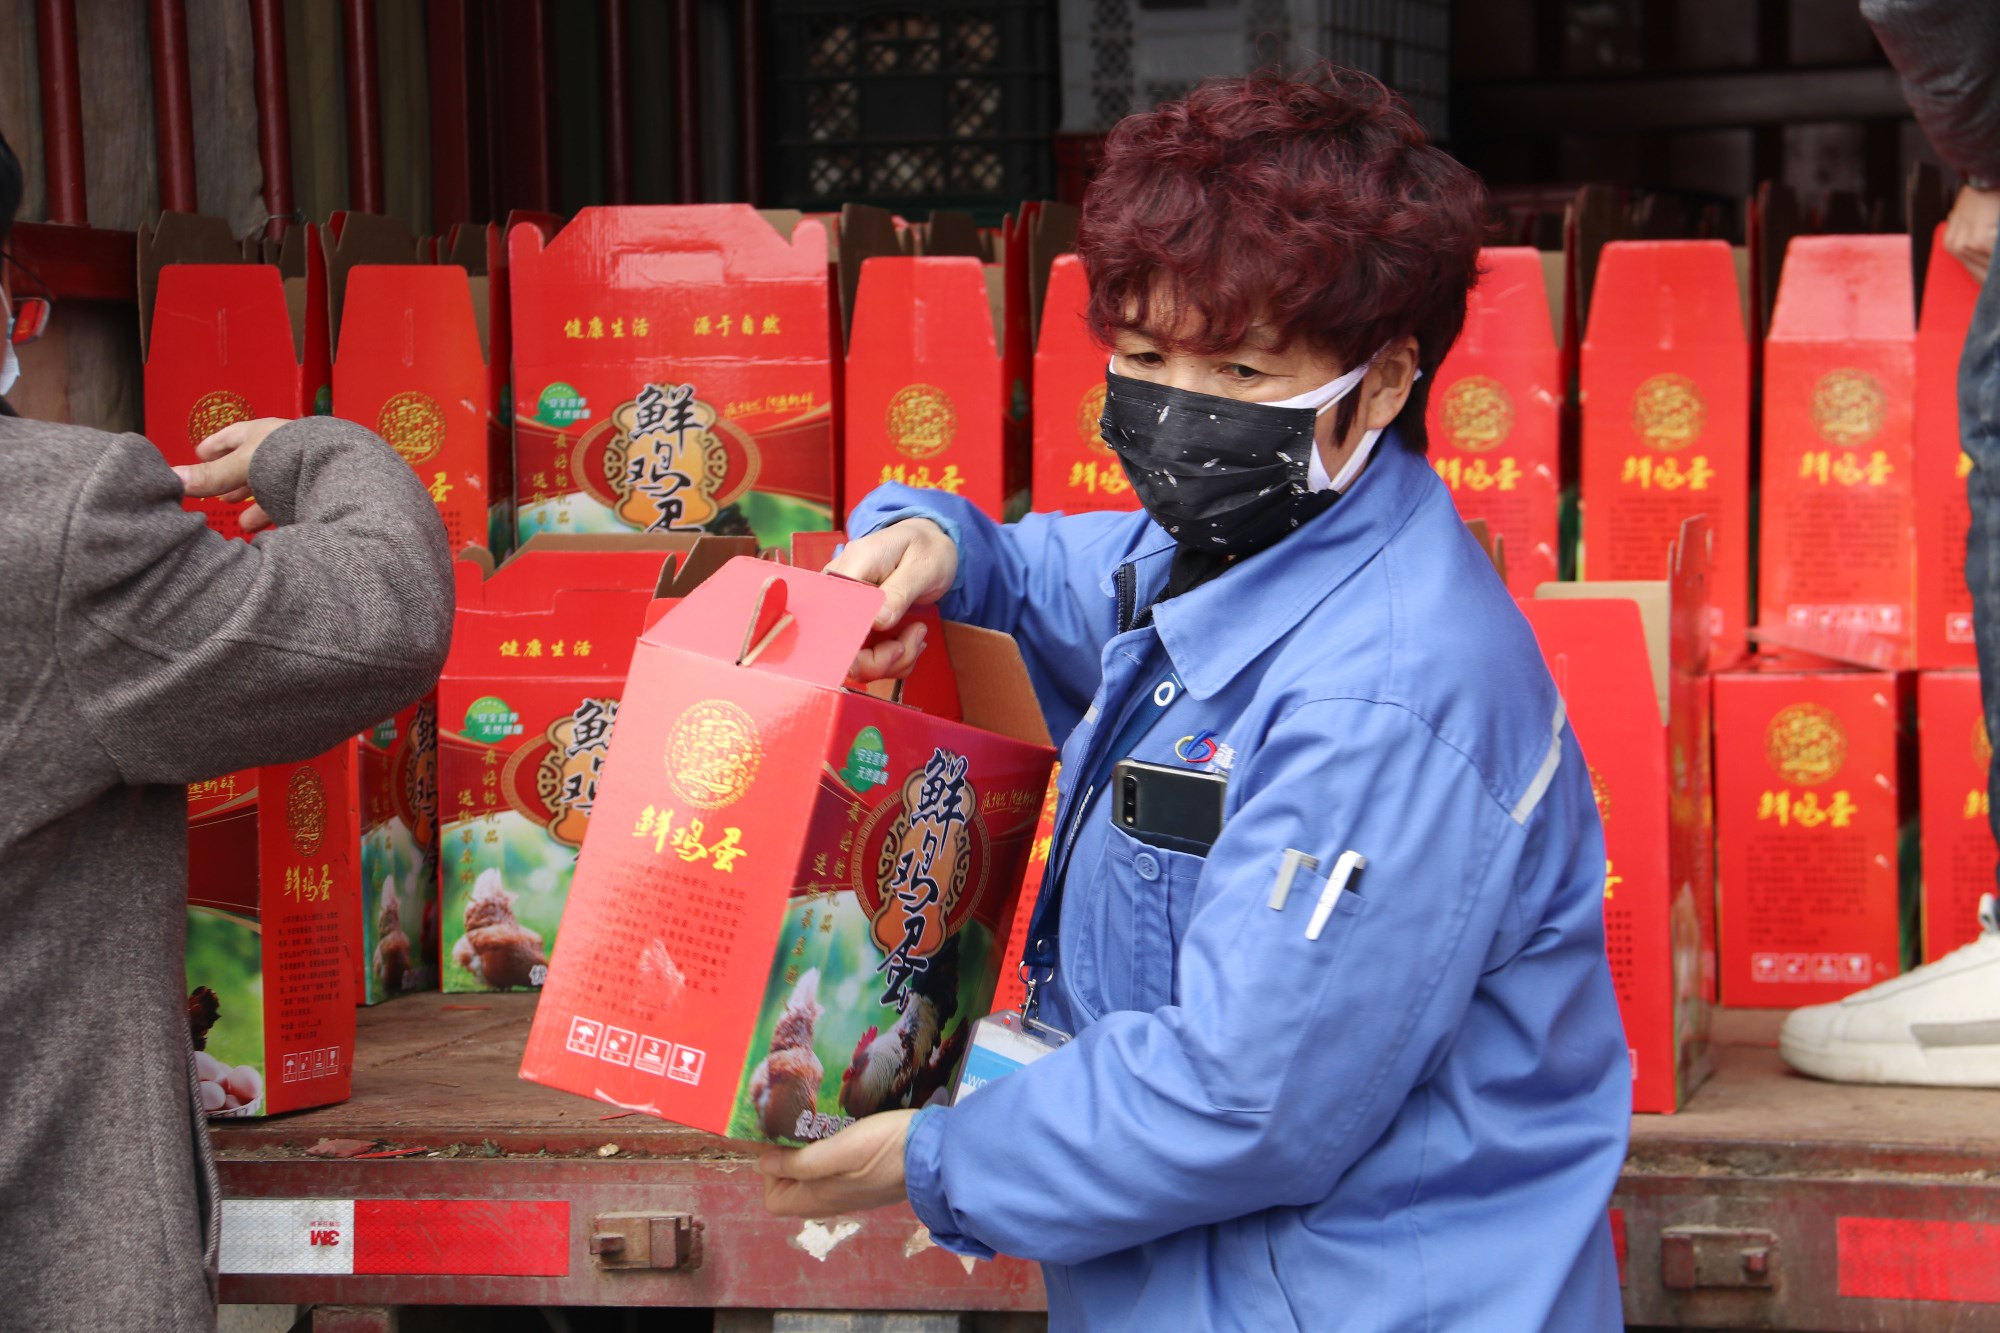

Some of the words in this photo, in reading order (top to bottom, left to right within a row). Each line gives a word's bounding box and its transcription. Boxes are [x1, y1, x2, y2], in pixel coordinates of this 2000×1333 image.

[564, 315, 650, 339] 健康生活
[693, 314, 782, 338] 源于自然
[1068, 460, 1131, 495] 鲜鸡
[1620, 454, 1716, 492] 鲜鸡蛋
[1798, 449, 1895, 486] 鲜鸡蛋
[499, 639, 593, 658] 健康生活
[476, 712, 520, 724] 安全营养
[481, 724, 524, 736] 天然健康
[1756, 789, 1859, 828] 鲜鸡蛋
[631, 803, 748, 874] 鲜鸡蛋
[283, 863, 334, 904] 鲜鸡蛋
[310, 1230, 340, 1247] 3M
